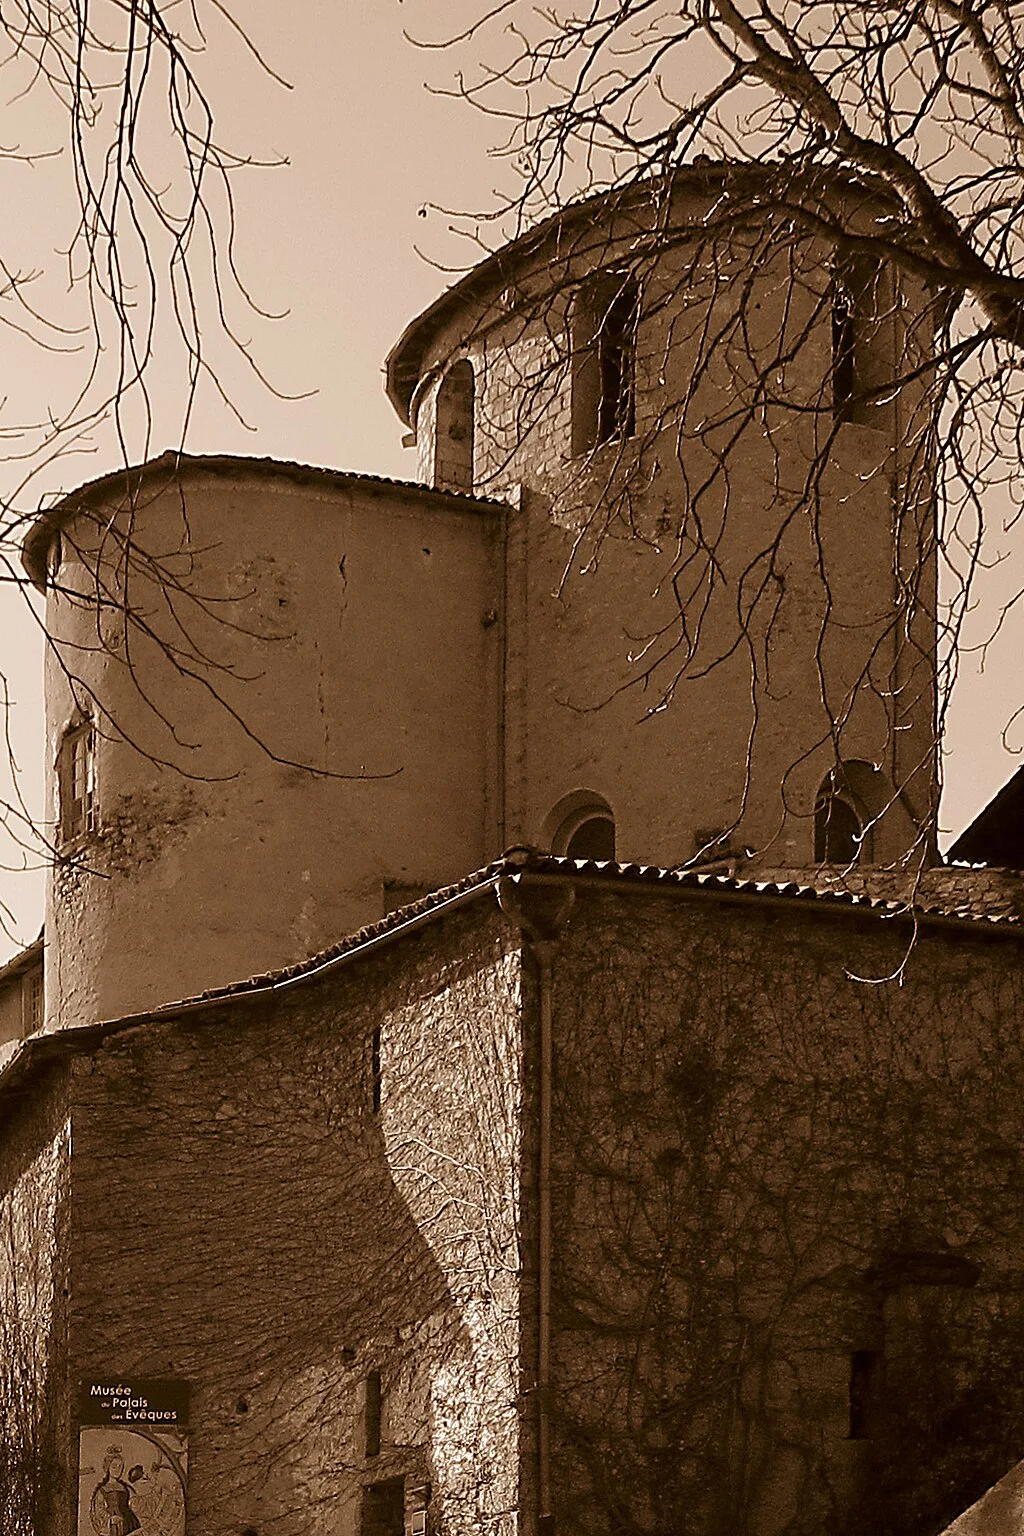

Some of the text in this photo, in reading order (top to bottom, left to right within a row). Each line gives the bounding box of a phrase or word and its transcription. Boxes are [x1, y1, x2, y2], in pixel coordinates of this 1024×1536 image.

[90, 1384, 131, 1395] Musée
[112, 1397, 148, 1408] Palais
[125, 1407, 177, 1421] Évêques
